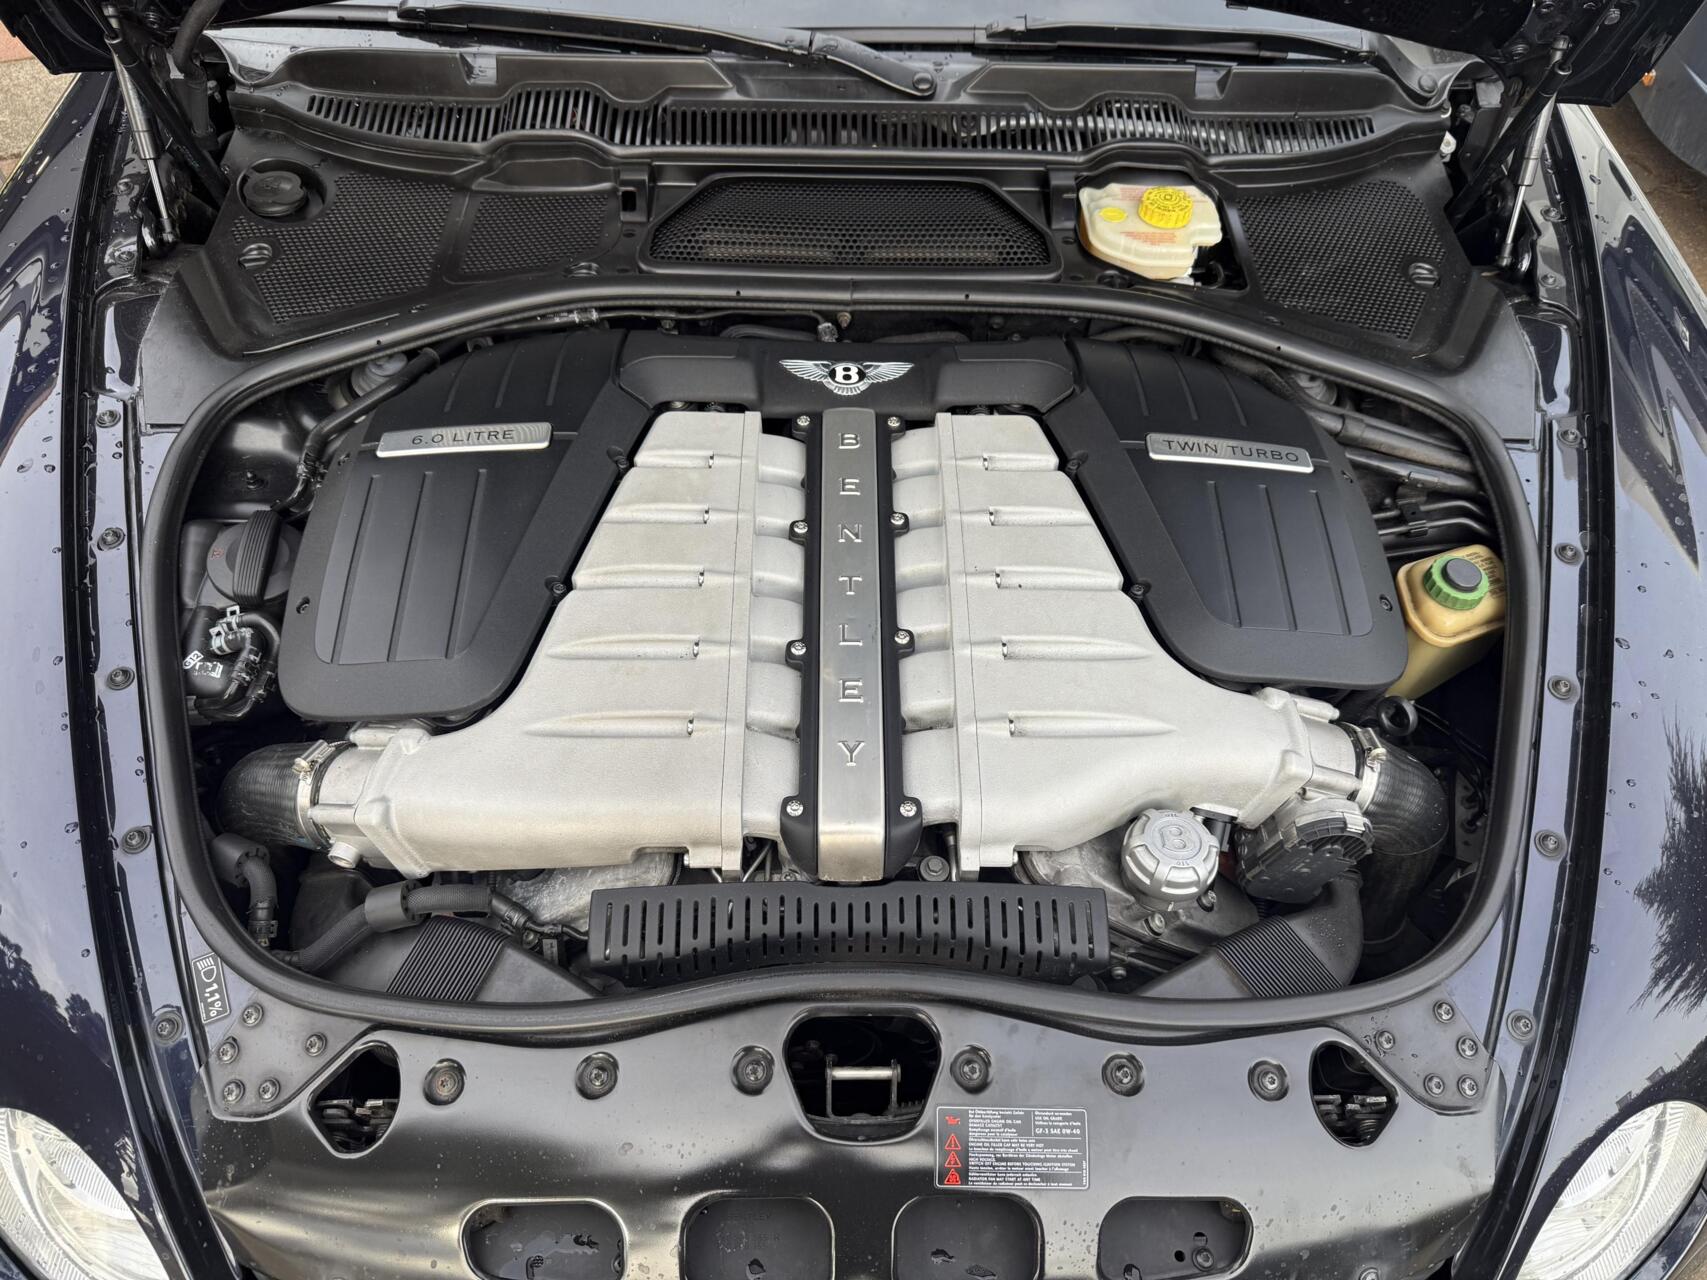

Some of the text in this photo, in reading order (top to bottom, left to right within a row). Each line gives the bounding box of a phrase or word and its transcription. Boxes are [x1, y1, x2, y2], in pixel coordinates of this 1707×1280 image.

[834, 364, 860, 384] B
[411, 430, 515, 445] 6.0 LITRE
[1162, 439, 1299, 462] TWIN TURBO
[838, 432, 865, 767] BENTLEY
[183, 652, 202, 667] G12
